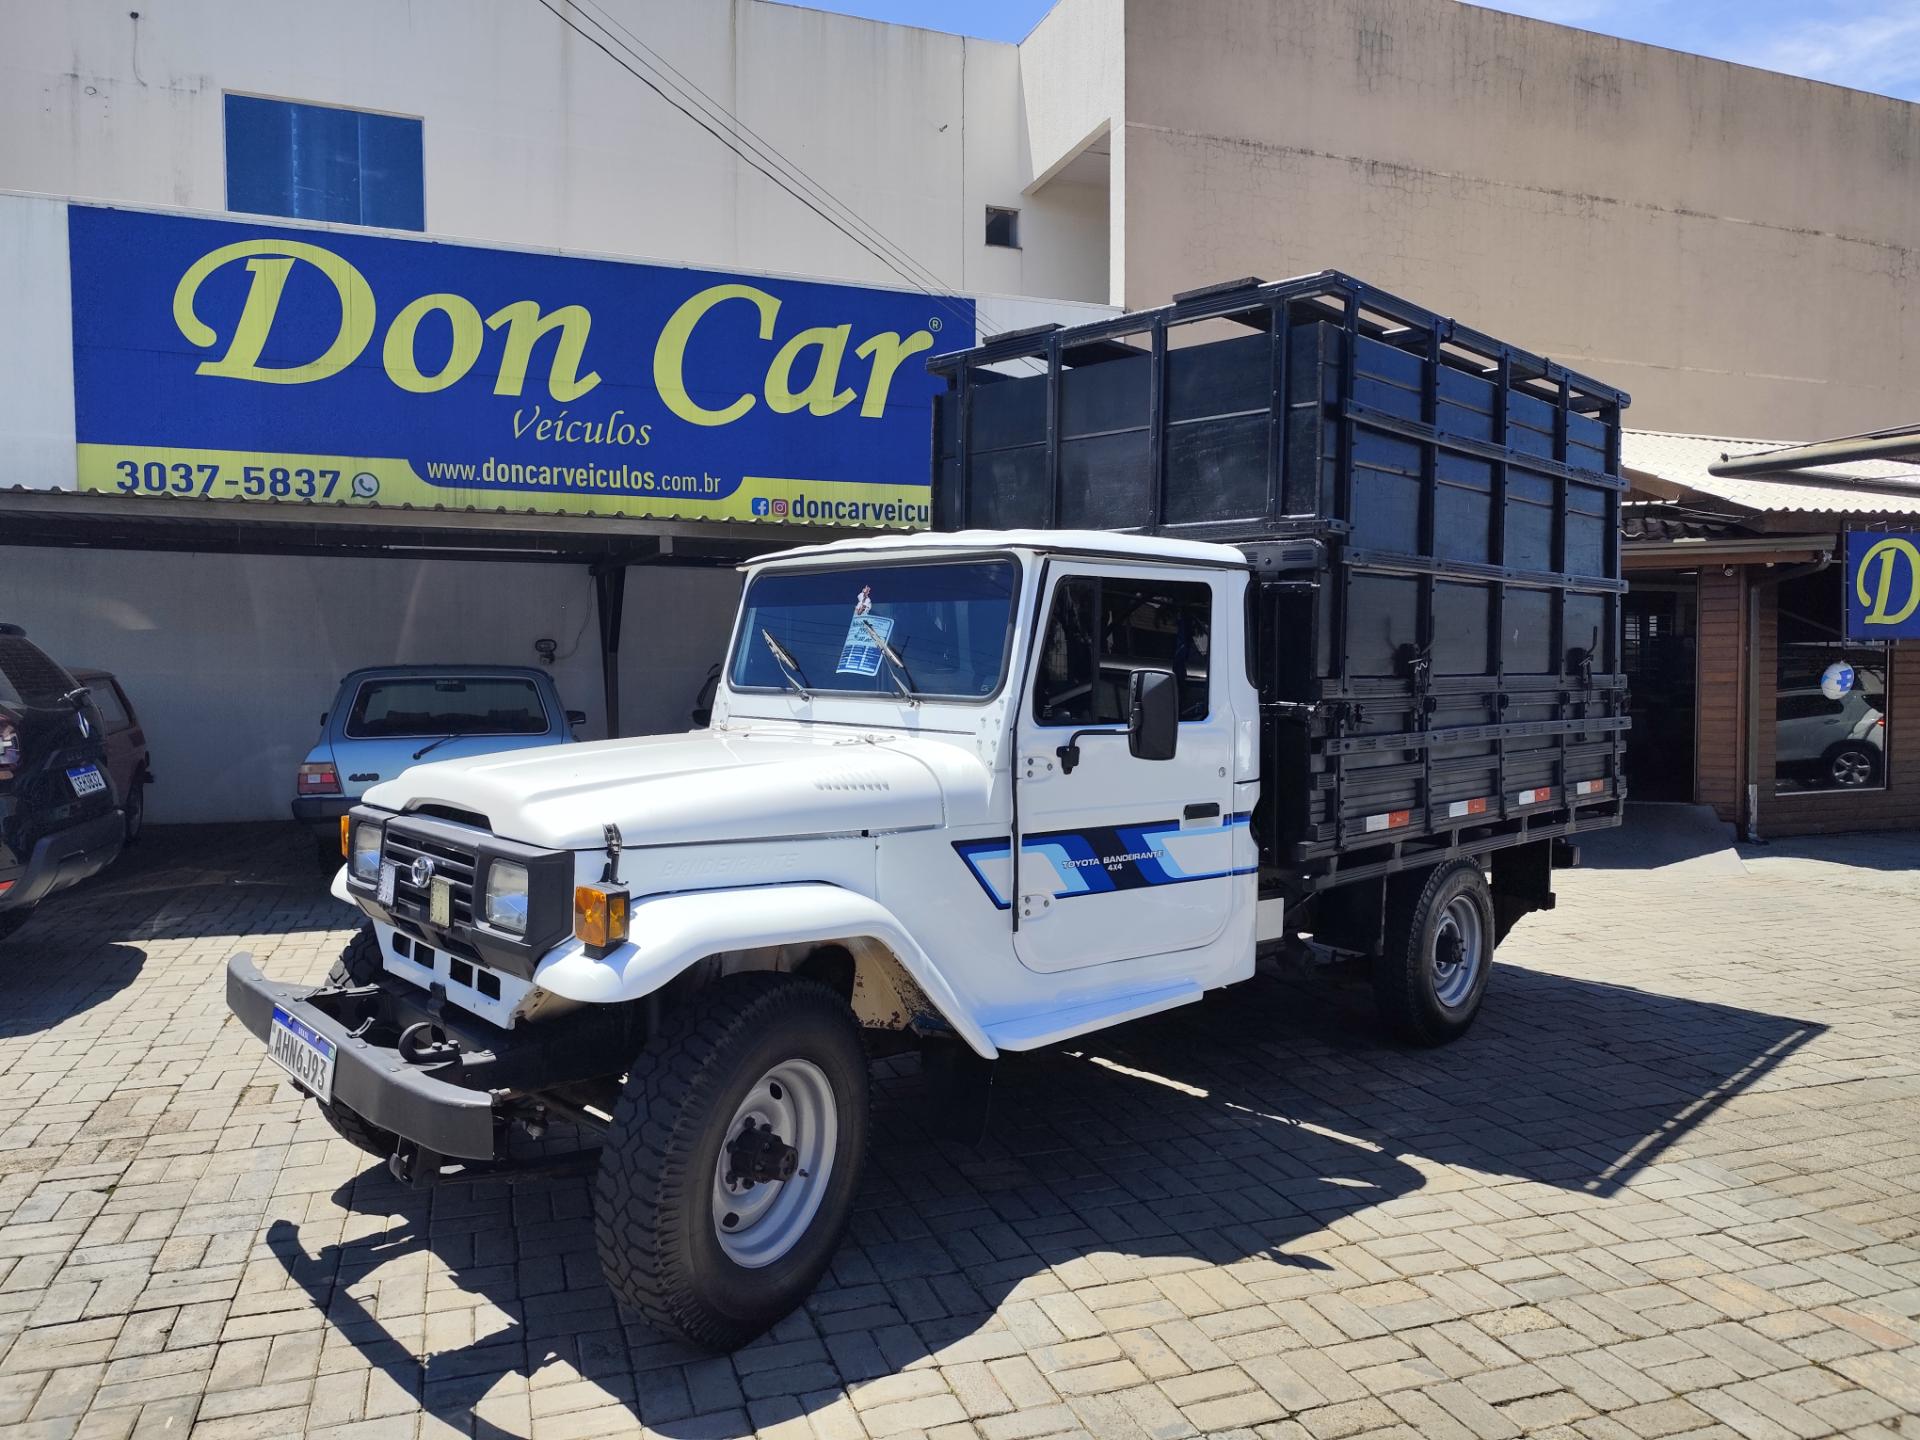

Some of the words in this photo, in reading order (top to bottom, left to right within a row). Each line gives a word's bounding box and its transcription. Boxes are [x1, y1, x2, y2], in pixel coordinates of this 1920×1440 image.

[173, 239, 602, 403] Don
[653, 284, 935, 427] Car
[513, 405, 652, 446] Veículos
[116, 461, 341, 499] 3037-5837
[427, 457, 721, 494] www.doncarveiculos.com.br
[1062, 858, 1100, 869] TOYOTA
[1103, 850, 1164, 864] BANDEIRANTE
[274, 1028, 328, 1090] AHN6J93
